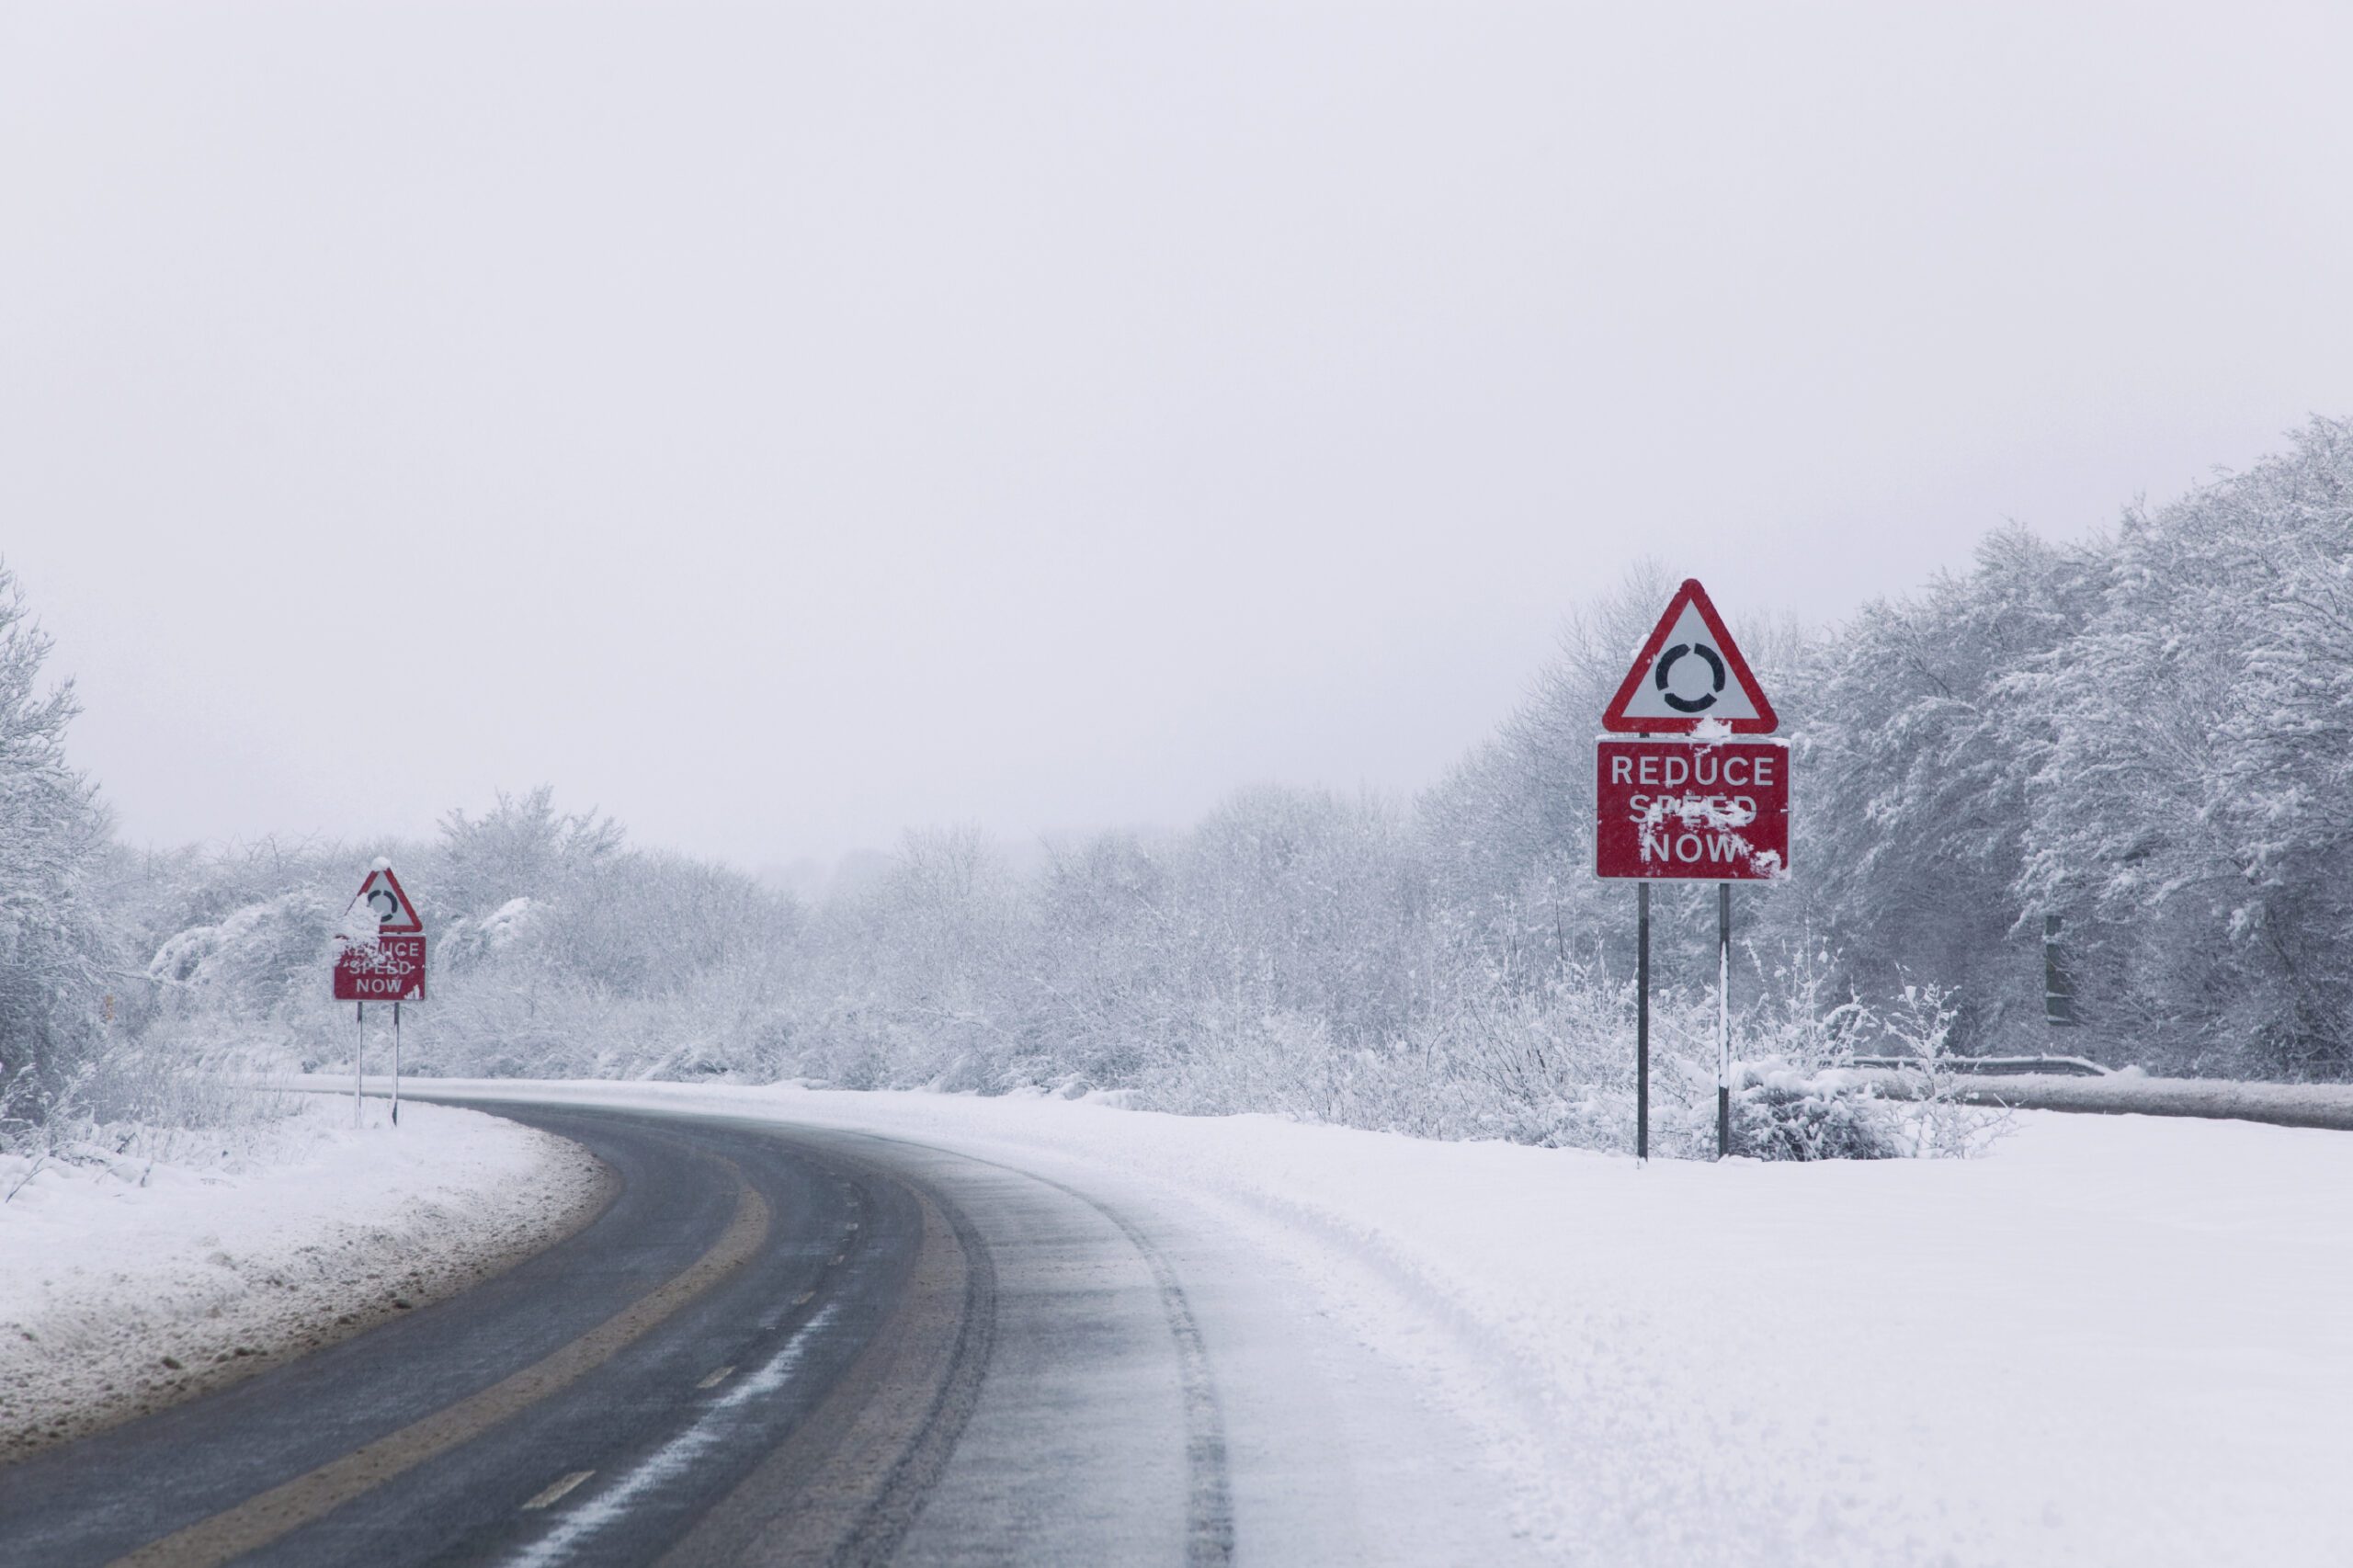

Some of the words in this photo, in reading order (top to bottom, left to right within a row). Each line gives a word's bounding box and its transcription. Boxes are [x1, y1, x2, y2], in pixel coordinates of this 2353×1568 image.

[1612, 756, 1774, 786] REDUCE
[1644, 834, 1740, 863] NOW
[344, 943, 418, 956] REUCE
[349, 960, 411, 974] SPEED
[356, 979, 402, 993] NOW
